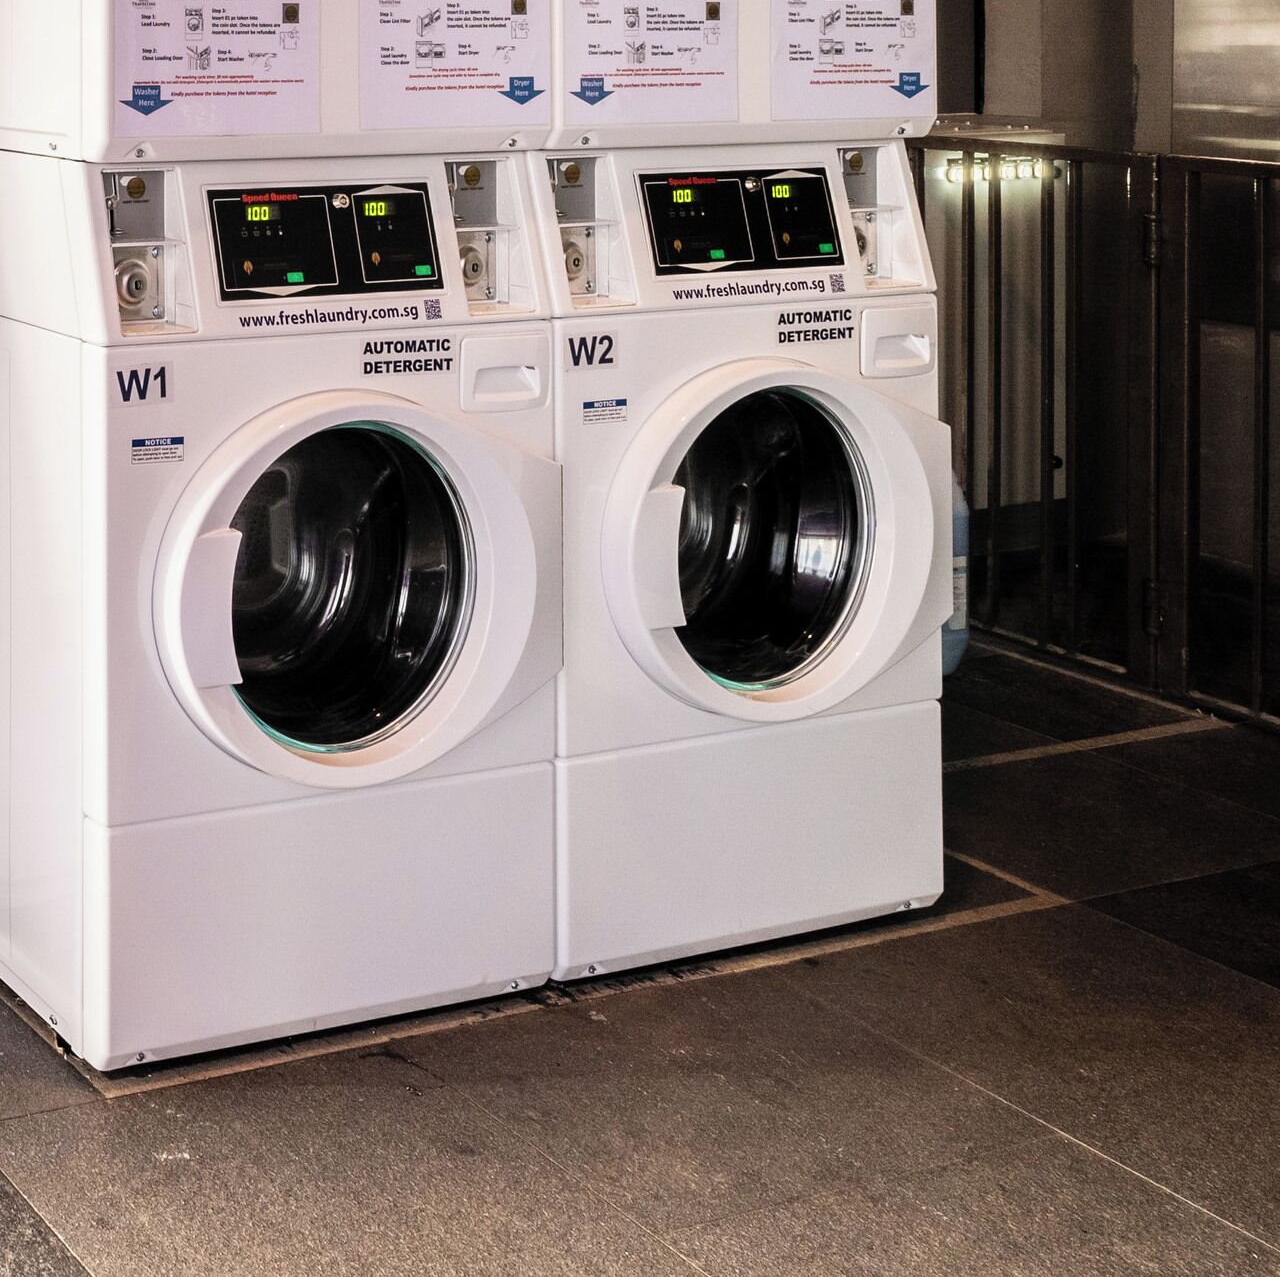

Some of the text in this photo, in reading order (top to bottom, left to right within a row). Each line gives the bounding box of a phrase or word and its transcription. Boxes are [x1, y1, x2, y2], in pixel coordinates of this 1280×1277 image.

[513, 79, 530, 88] Dryer
[581, 80, 603, 88] Washer
[902, 74, 917, 83] Dryer
[134, 87, 160, 96] Washer
[515, 89, 529, 97] Here
[138, 99, 155, 107] Here
[242, 192, 300, 203] Speed Queen
[672, 189, 692, 203] 100
[771, 184, 790, 199] 100
[247, 206, 270, 221] 100
[364, 201, 386, 217] 100
[672, 277, 826, 301] www.freshlaundry.com.sg
[239, 304, 419, 328] www.freshlaundry.com.sg
[777, 308, 853, 326] AUTOMATIC
[777, 326, 855, 344] DETERGENT
[363, 338, 452, 356] AUTOMATIC
[568, 334, 615, 368] W2
[363, 357, 454, 375] DETERGENT
[116, 366, 168, 403] W1
[593, 399, 617, 409] NOTICE
[144, 438, 172, 446] NOTICE
